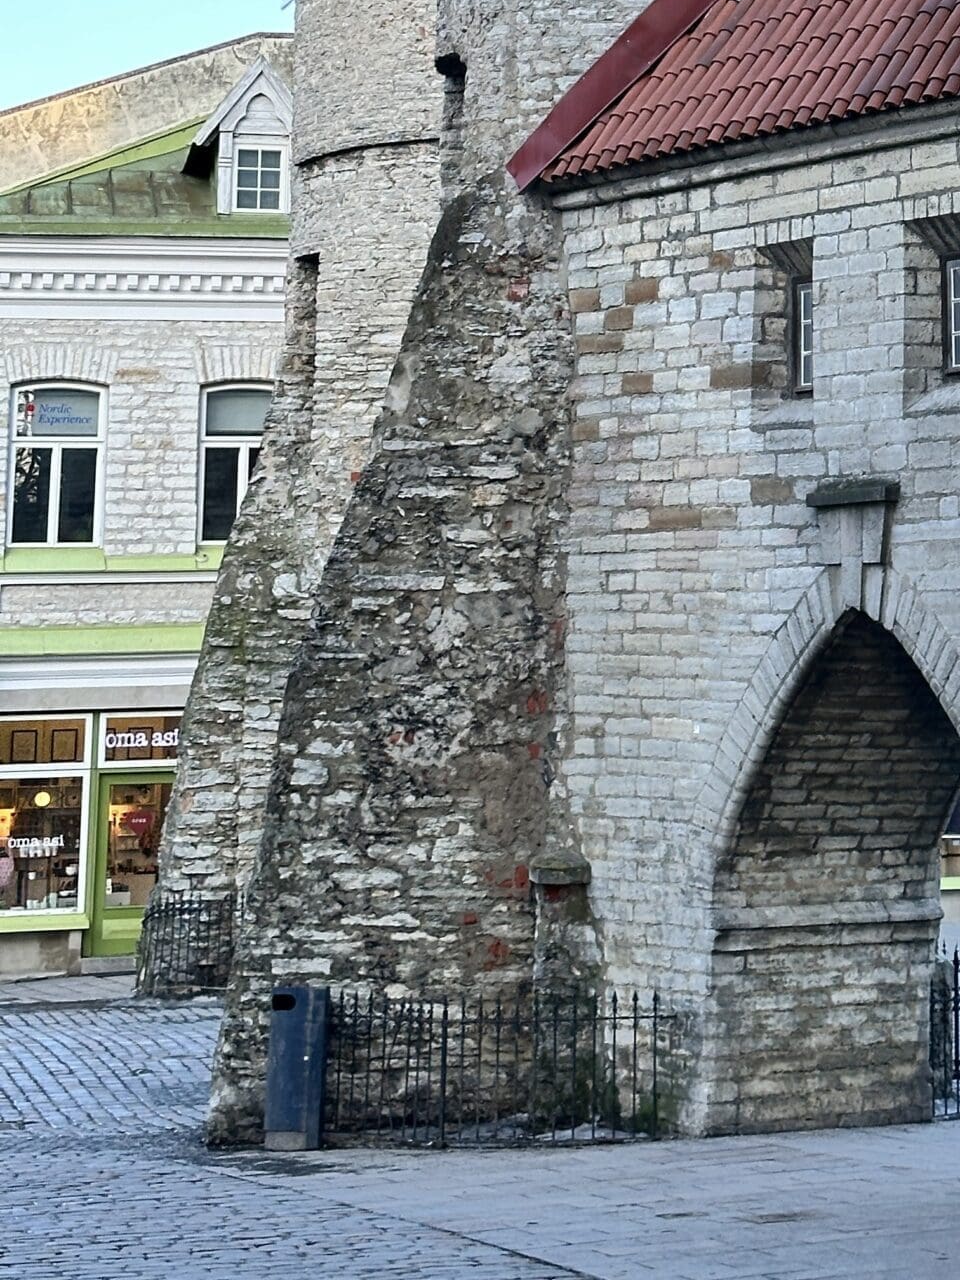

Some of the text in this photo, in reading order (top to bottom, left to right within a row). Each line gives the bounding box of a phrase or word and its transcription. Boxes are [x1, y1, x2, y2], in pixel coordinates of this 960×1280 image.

[39, 403, 72, 414] Nordic
[38, 415, 92, 426] Experience
[106, 728, 179, 748] oma asi
[8, 834, 65, 849] oma asi
